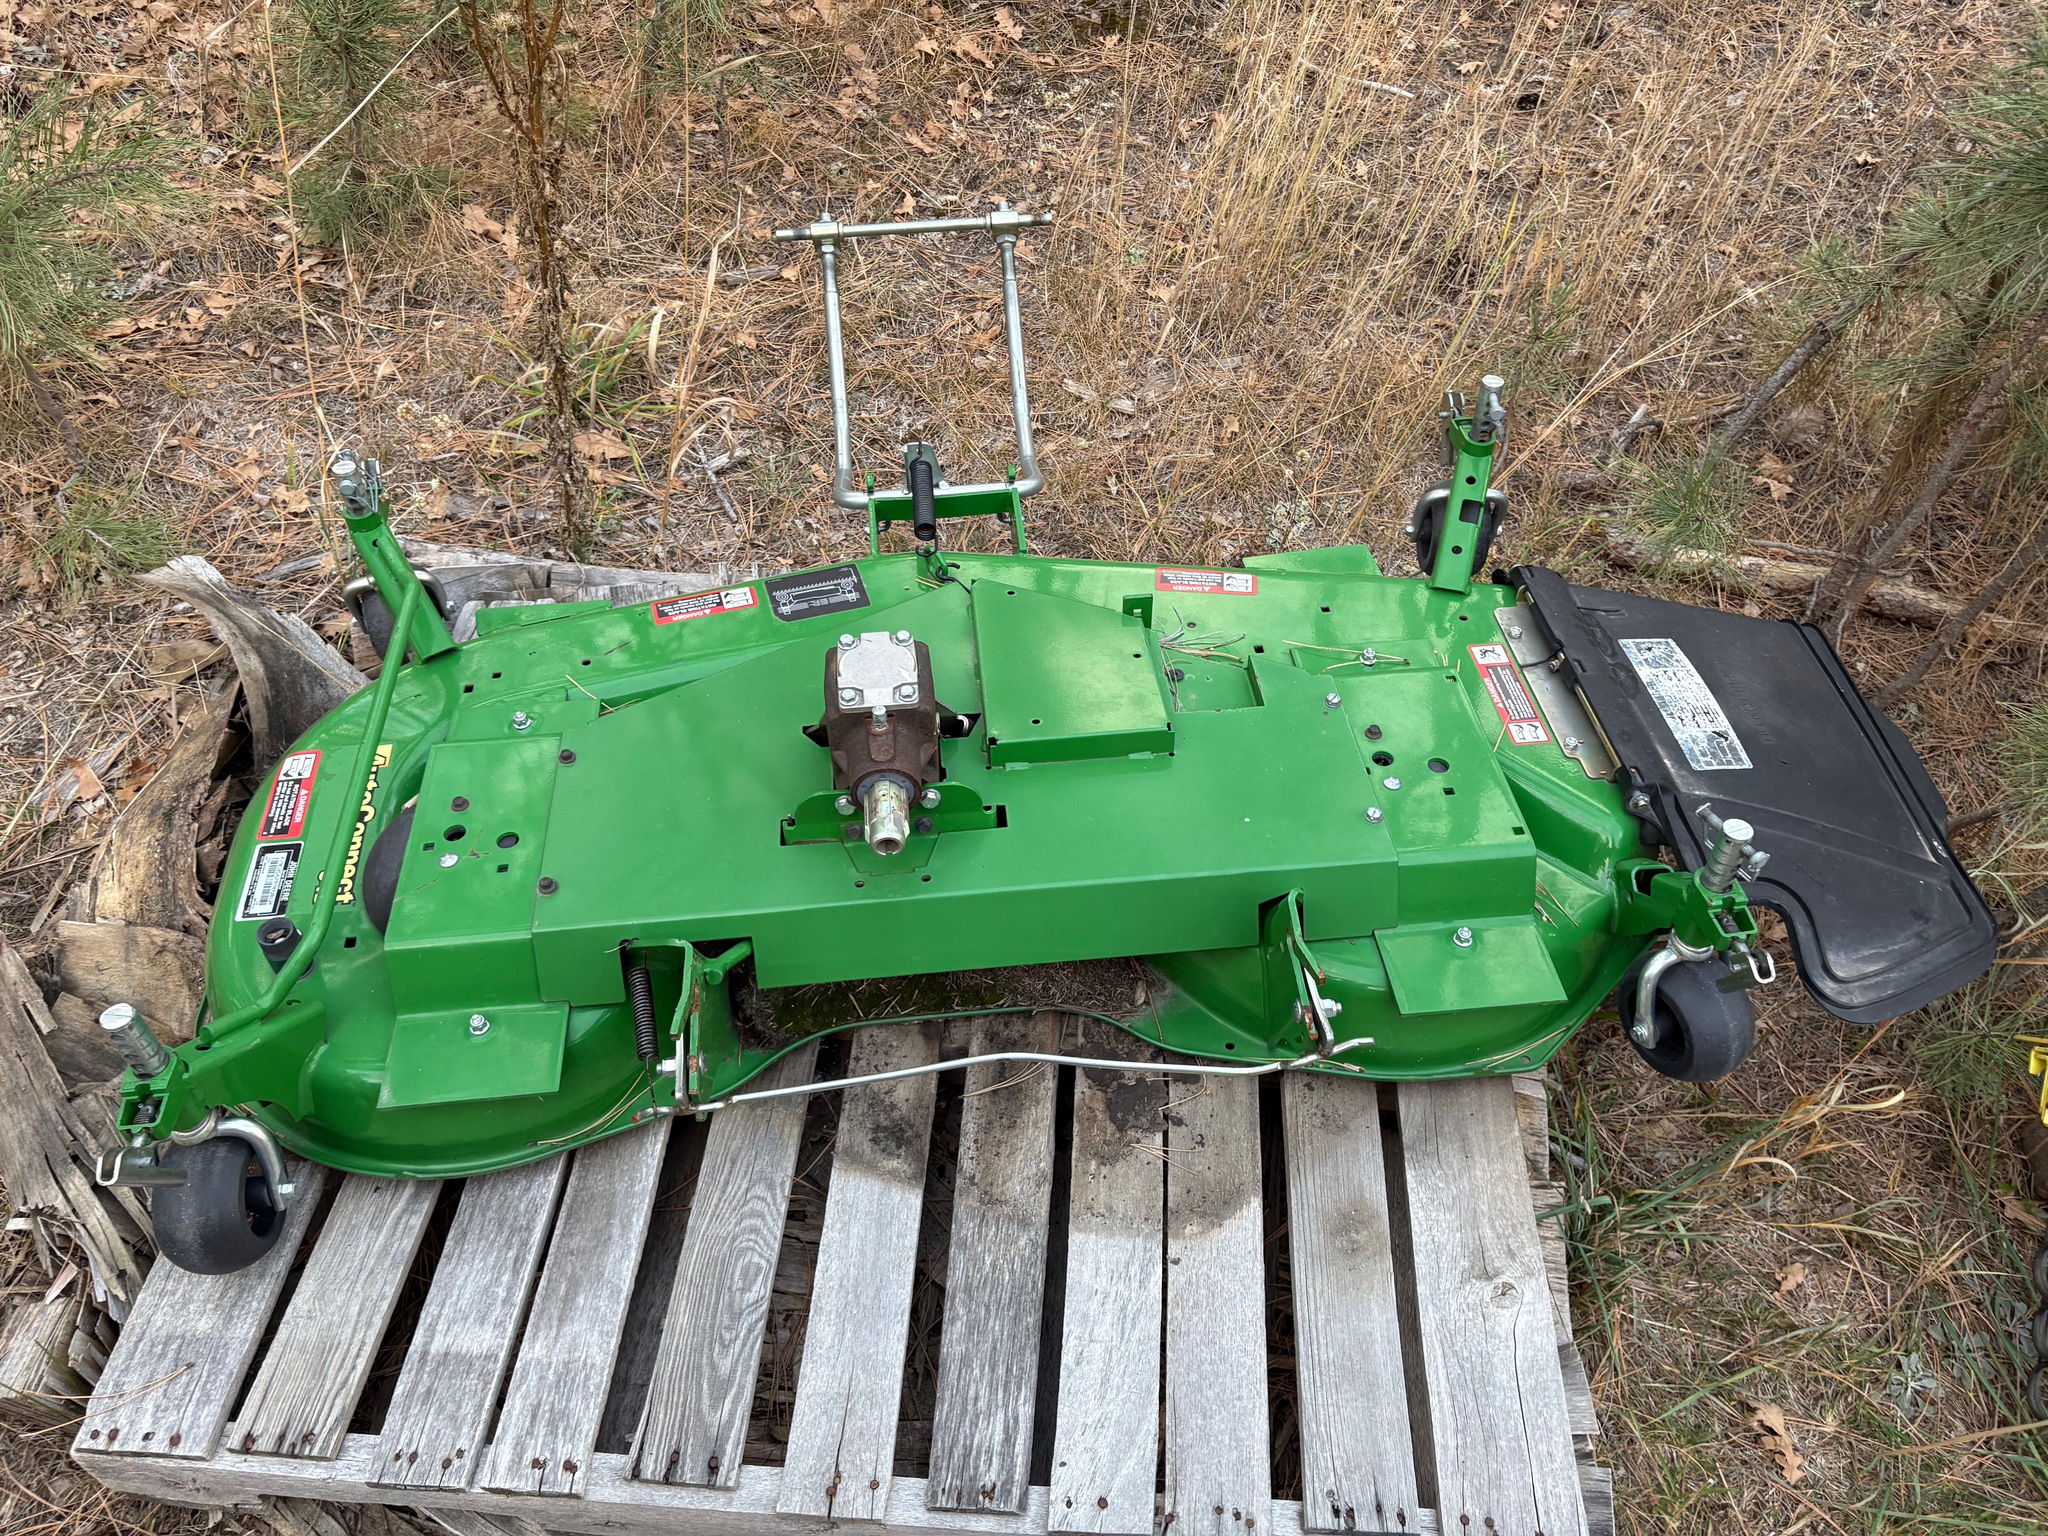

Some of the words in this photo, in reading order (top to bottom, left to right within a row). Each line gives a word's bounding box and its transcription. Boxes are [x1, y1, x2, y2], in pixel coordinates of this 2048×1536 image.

[672, 611, 703, 620] DANGER
[1483, 677, 1501, 702] DANGER
[288, 783, 299, 808] ROTATING
[283, 809, 292, 825] BLADE
[293, 795, 307, 822] DANGER
[288, 860, 297, 878] JOHN
[281, 879, 291, 901] DEERE
